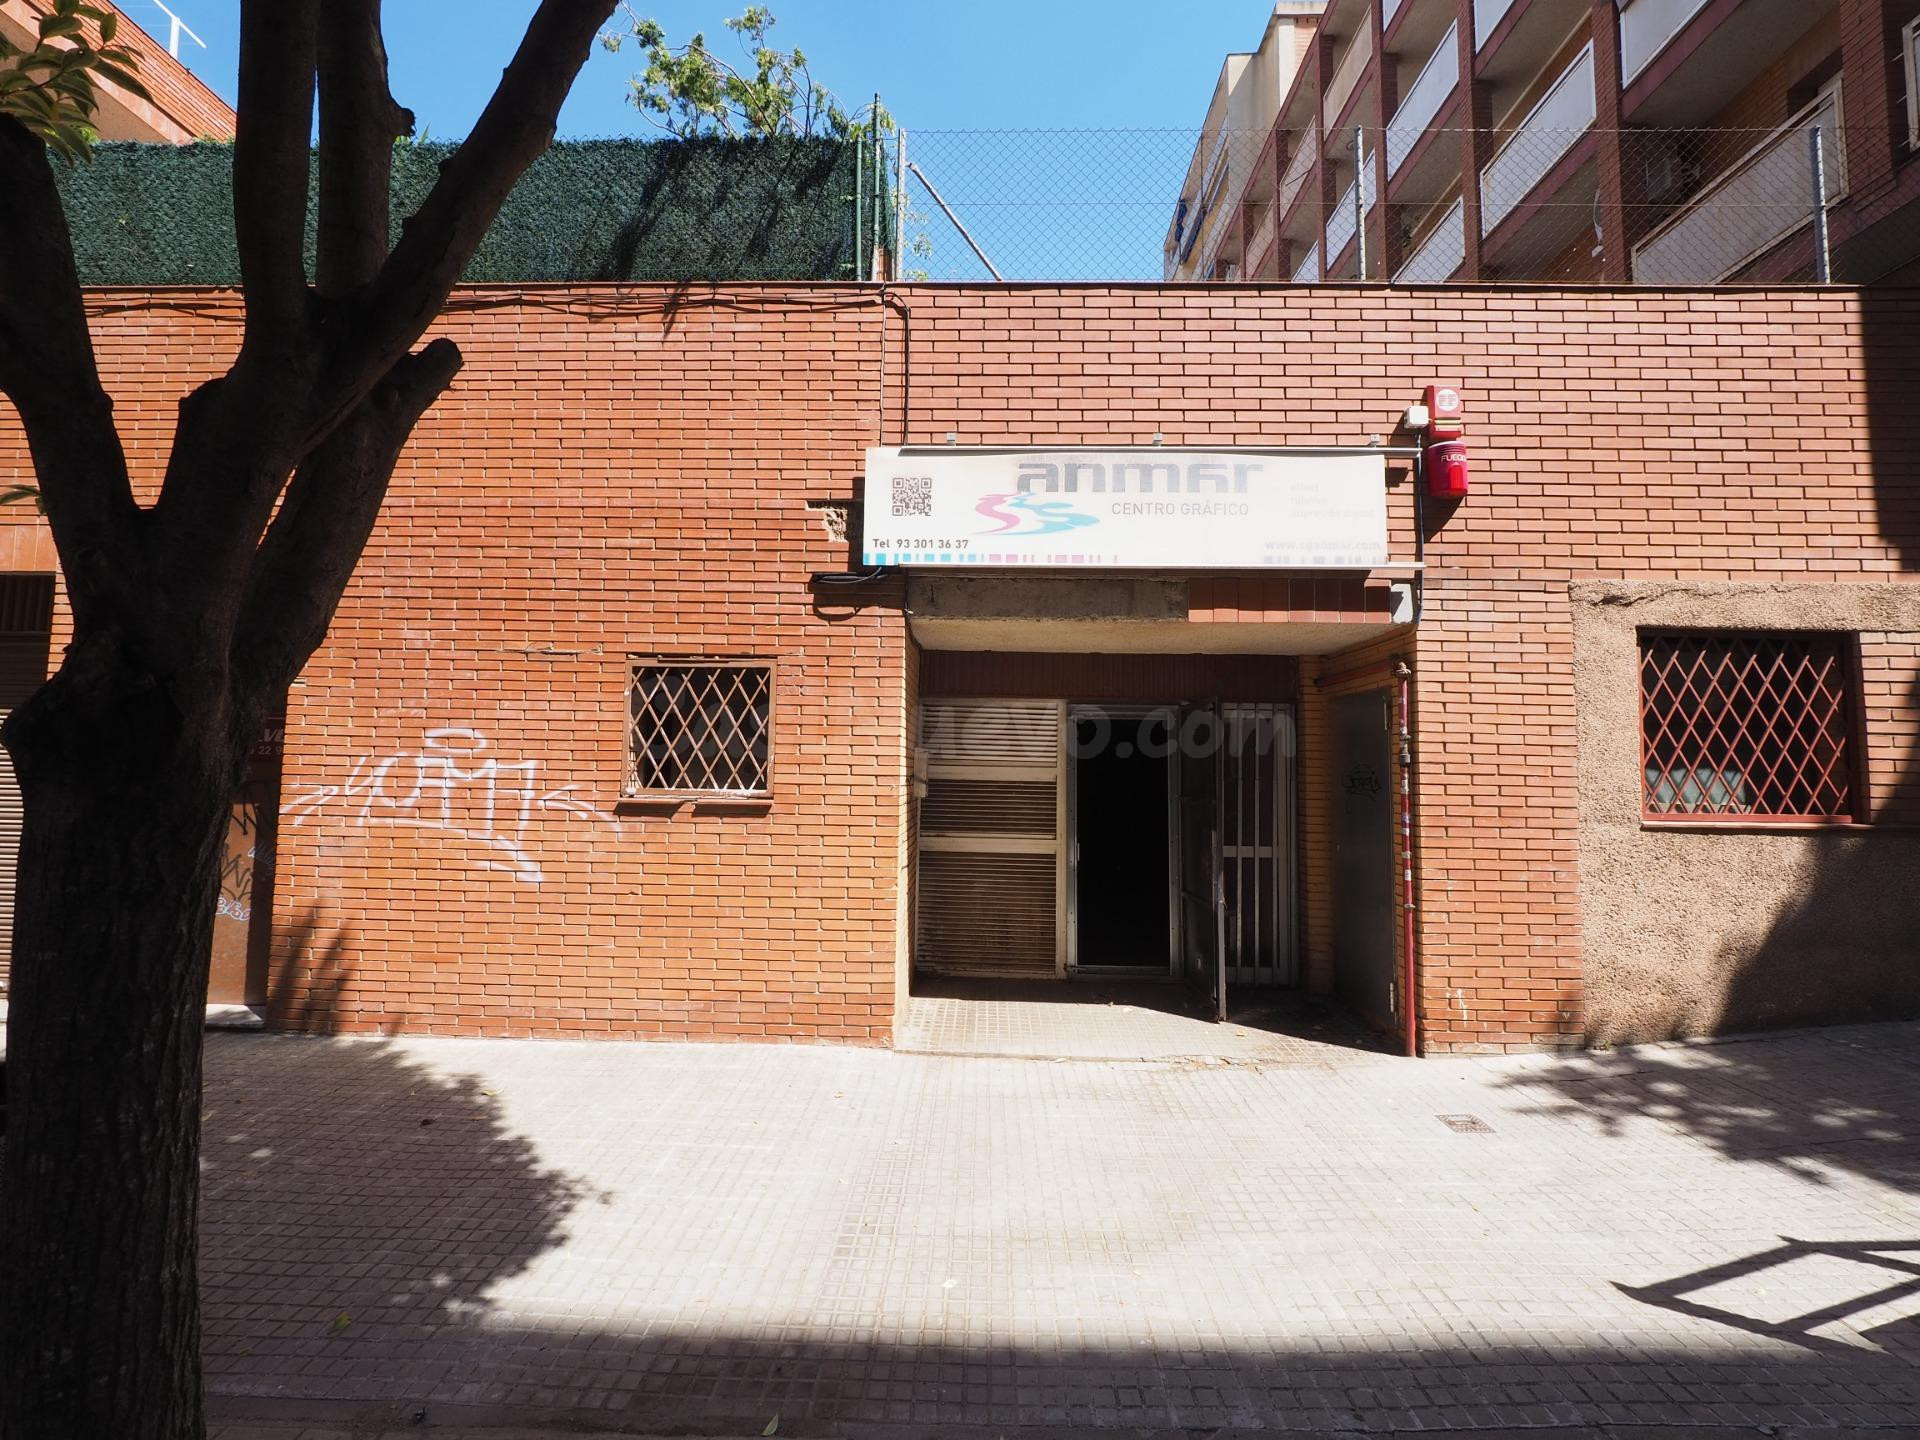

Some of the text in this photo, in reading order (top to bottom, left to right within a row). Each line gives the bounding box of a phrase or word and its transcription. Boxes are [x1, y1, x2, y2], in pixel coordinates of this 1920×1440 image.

[1441, 453, 1467, 463] FUEGO
[1017, 463, 1264, 493] anmar
[1111, 499, 1249, 516] CENTRO GRÁFICO
[872, 538, 969, 549] Tel 93 301 36 37
